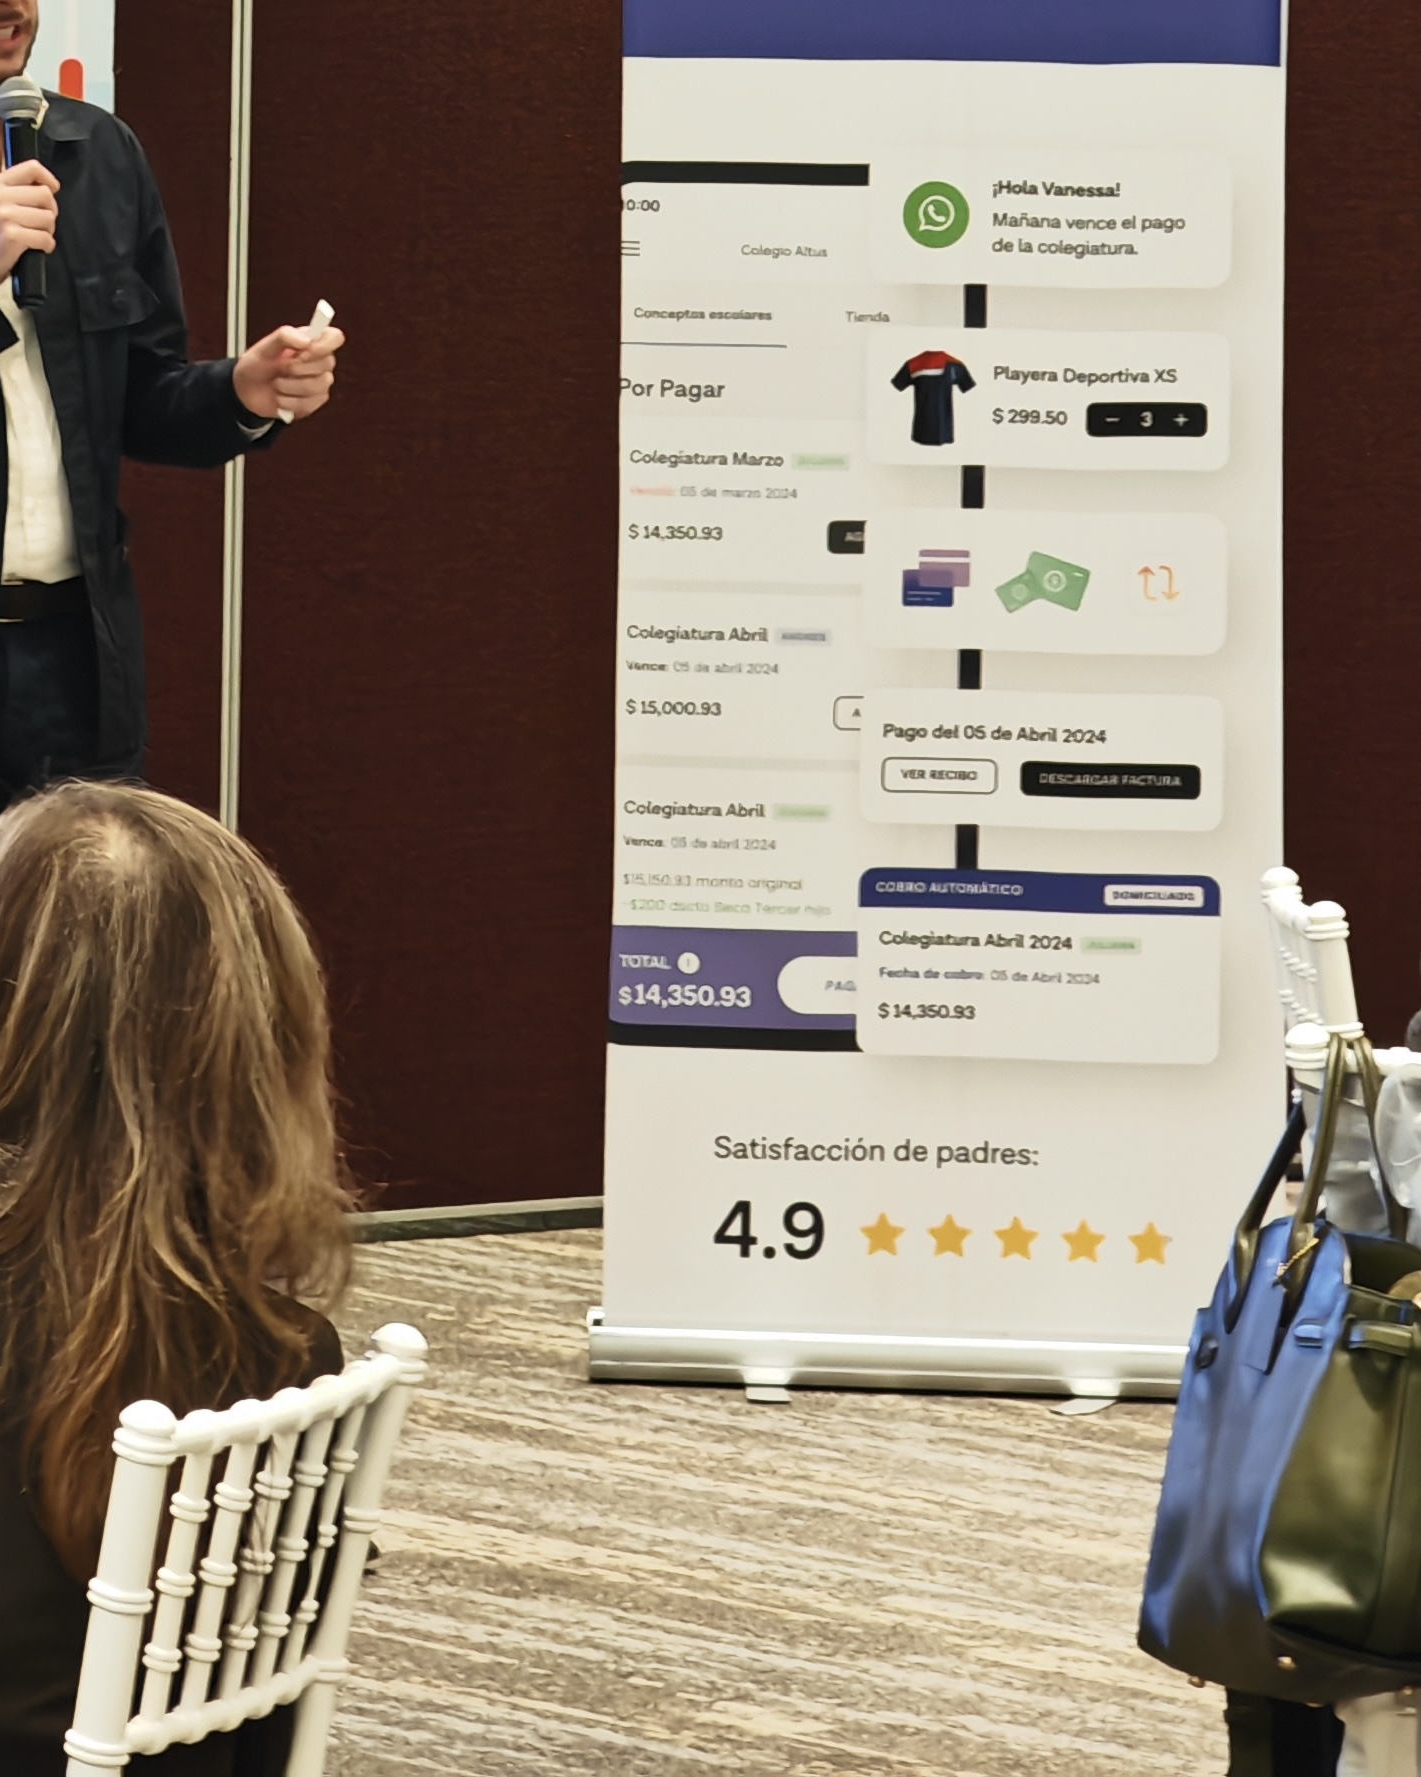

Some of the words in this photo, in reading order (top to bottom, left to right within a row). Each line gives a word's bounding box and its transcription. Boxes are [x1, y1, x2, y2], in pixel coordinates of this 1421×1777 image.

[992, 179, 1039, 198] ¡Hola
[1041, 181, 1122, 199] Vanessa!
[622, 198, 661, 213] 0:00
[992, 212, 1062, 230] Mañana
[1065, 216, 1118, 231] vence
[1121, 214, 1137, 231] el
[1140, 217, 1187, 234] pago
[740, 244, 792, 260] Colegio
[794, 245, 828, 258] Altus
[992, 238, 1015, 254] de
[1018, 238, 1034, 254] la
[1037, 239, 1139, 259] colegiatura.
[633, 307, 706, 322] Conceptos
[709, 309, 773, 321] escolares
[845, 311, 891, 324] Tienda
[993, 366, 1058, 387] Playera
[1063, 367, 1150, 387] Deportiva
[1154, 368, 1178, 384] XS
[620, 377, 655, 398] Por
[659, 378, 726, 403] Pagar
[1139, 410, 1154, 428] 3
[629, 449, 728, 469] Colegiatura
[731, 451, 785, 468] Marzo
[626, 624, 725, 643] Colegiatura
[728, 627, 769, 643] Abril
[882, 723, 929, 743] Pago
[931, 724, 960, 741] del
[963, 725, 987, 741] 05
[990, 725, 1013, 742] de
[1016, 726, 1058, 744] Abril
[1062, 727, 1108, 745] 2024
[900, 768, 927, 781] VER
[928, 768, 979, 782] RECIBO
[1037, 772, 1118, 786] DESCARGAR
[1121, 773, 1184, 788] FACTURA
[623, 800, 723, 820] Colegiatura
[725, 802, 766, 818] Abril
[878, 929, 980, 950] Colegiatura
[983, 932, 1025, 950] Abril
[1028, 933, 1074, 951] 2024
[618, 954, 672, 970] TOTAL
[618, 982, 752, 1009] $14,350.93
[713, 1134, 886, 1163] Satisfacción
[893, 1137, 929, 1164] de
[936, 1139, 1040, 1169] padres:
[713, 1198, 826, 1261] 4.9
